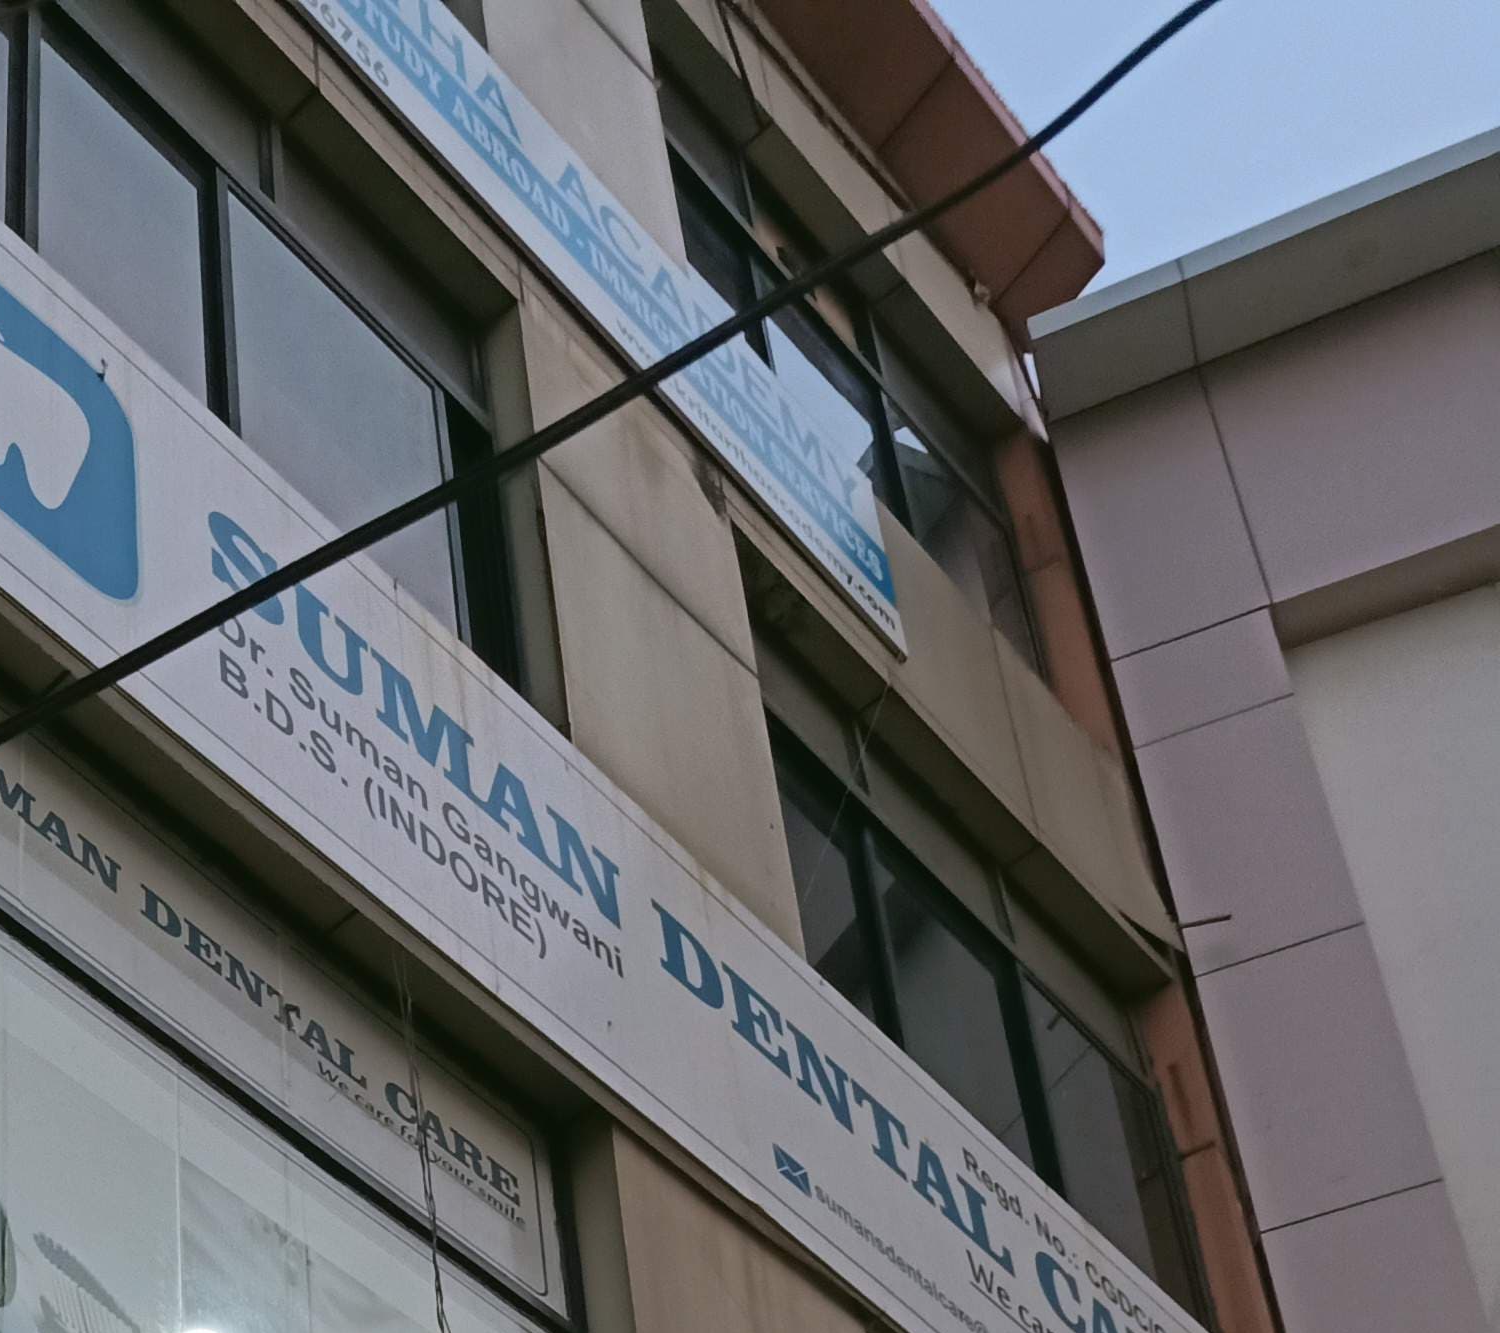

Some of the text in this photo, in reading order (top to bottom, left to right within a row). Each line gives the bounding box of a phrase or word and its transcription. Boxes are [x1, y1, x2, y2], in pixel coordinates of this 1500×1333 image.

[350, 0, 442, 98] TUDY
[453, 97, 571, 238] ABROAD
[770, 440, 884, 583] SERVICES
[208, 511, 621, 931] SUMAN
[651, 898, 1015, 1277] DENTAL
[218, 614, 624, 979] Dr. Suman Gangwani
[219, 650, 548, 960] B.D.S. (INDORE)
[140, 883, 368, 1090] DENTAL
[384, 1081, 521, 1208] CARE
[318, 1060, 349, 1094] We
[962, 1147, 1030, 1225] Regd.
[965, 1249, 1011, 1310] We
